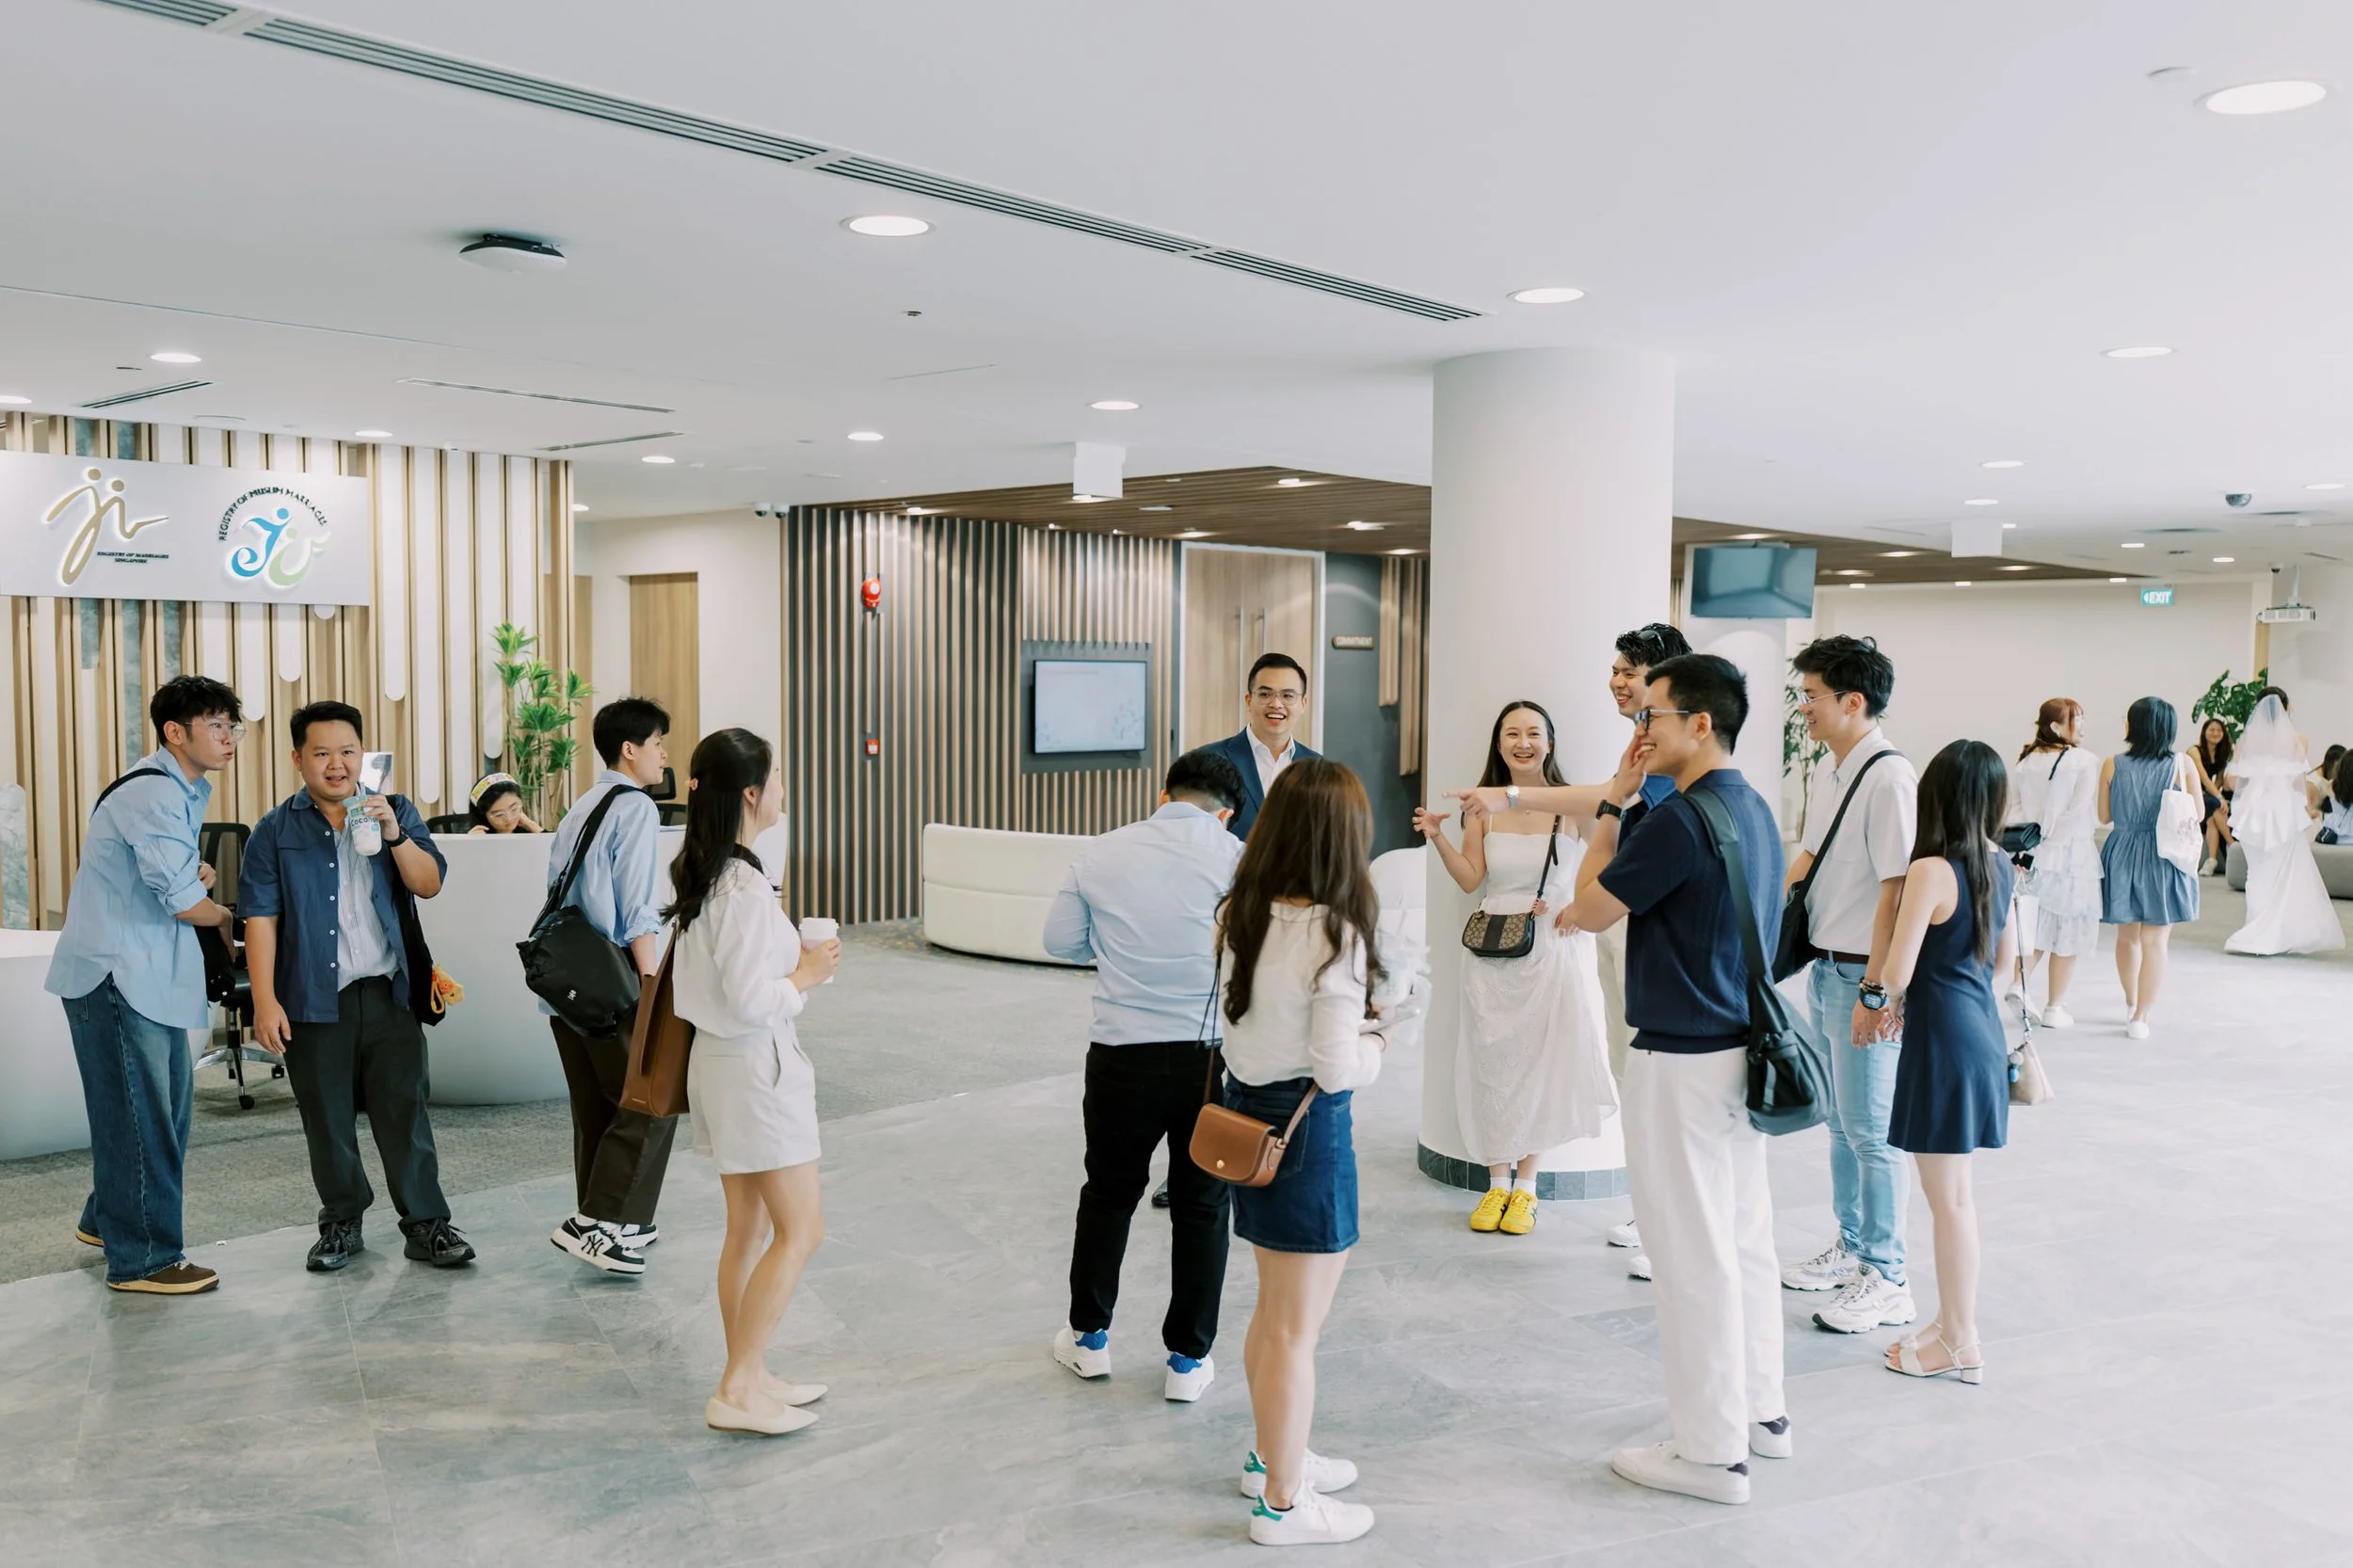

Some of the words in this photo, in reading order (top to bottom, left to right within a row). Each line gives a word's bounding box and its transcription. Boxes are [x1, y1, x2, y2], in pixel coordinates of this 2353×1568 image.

[217, 502, 239, 541] REGISTRY
[236, 494, 249, 504] OF
[248, 486, 284, 498] MUSLIM
[285, 488, 328, 526] MARRIAGES
[2149, 590, 2172, 604] EXIT
